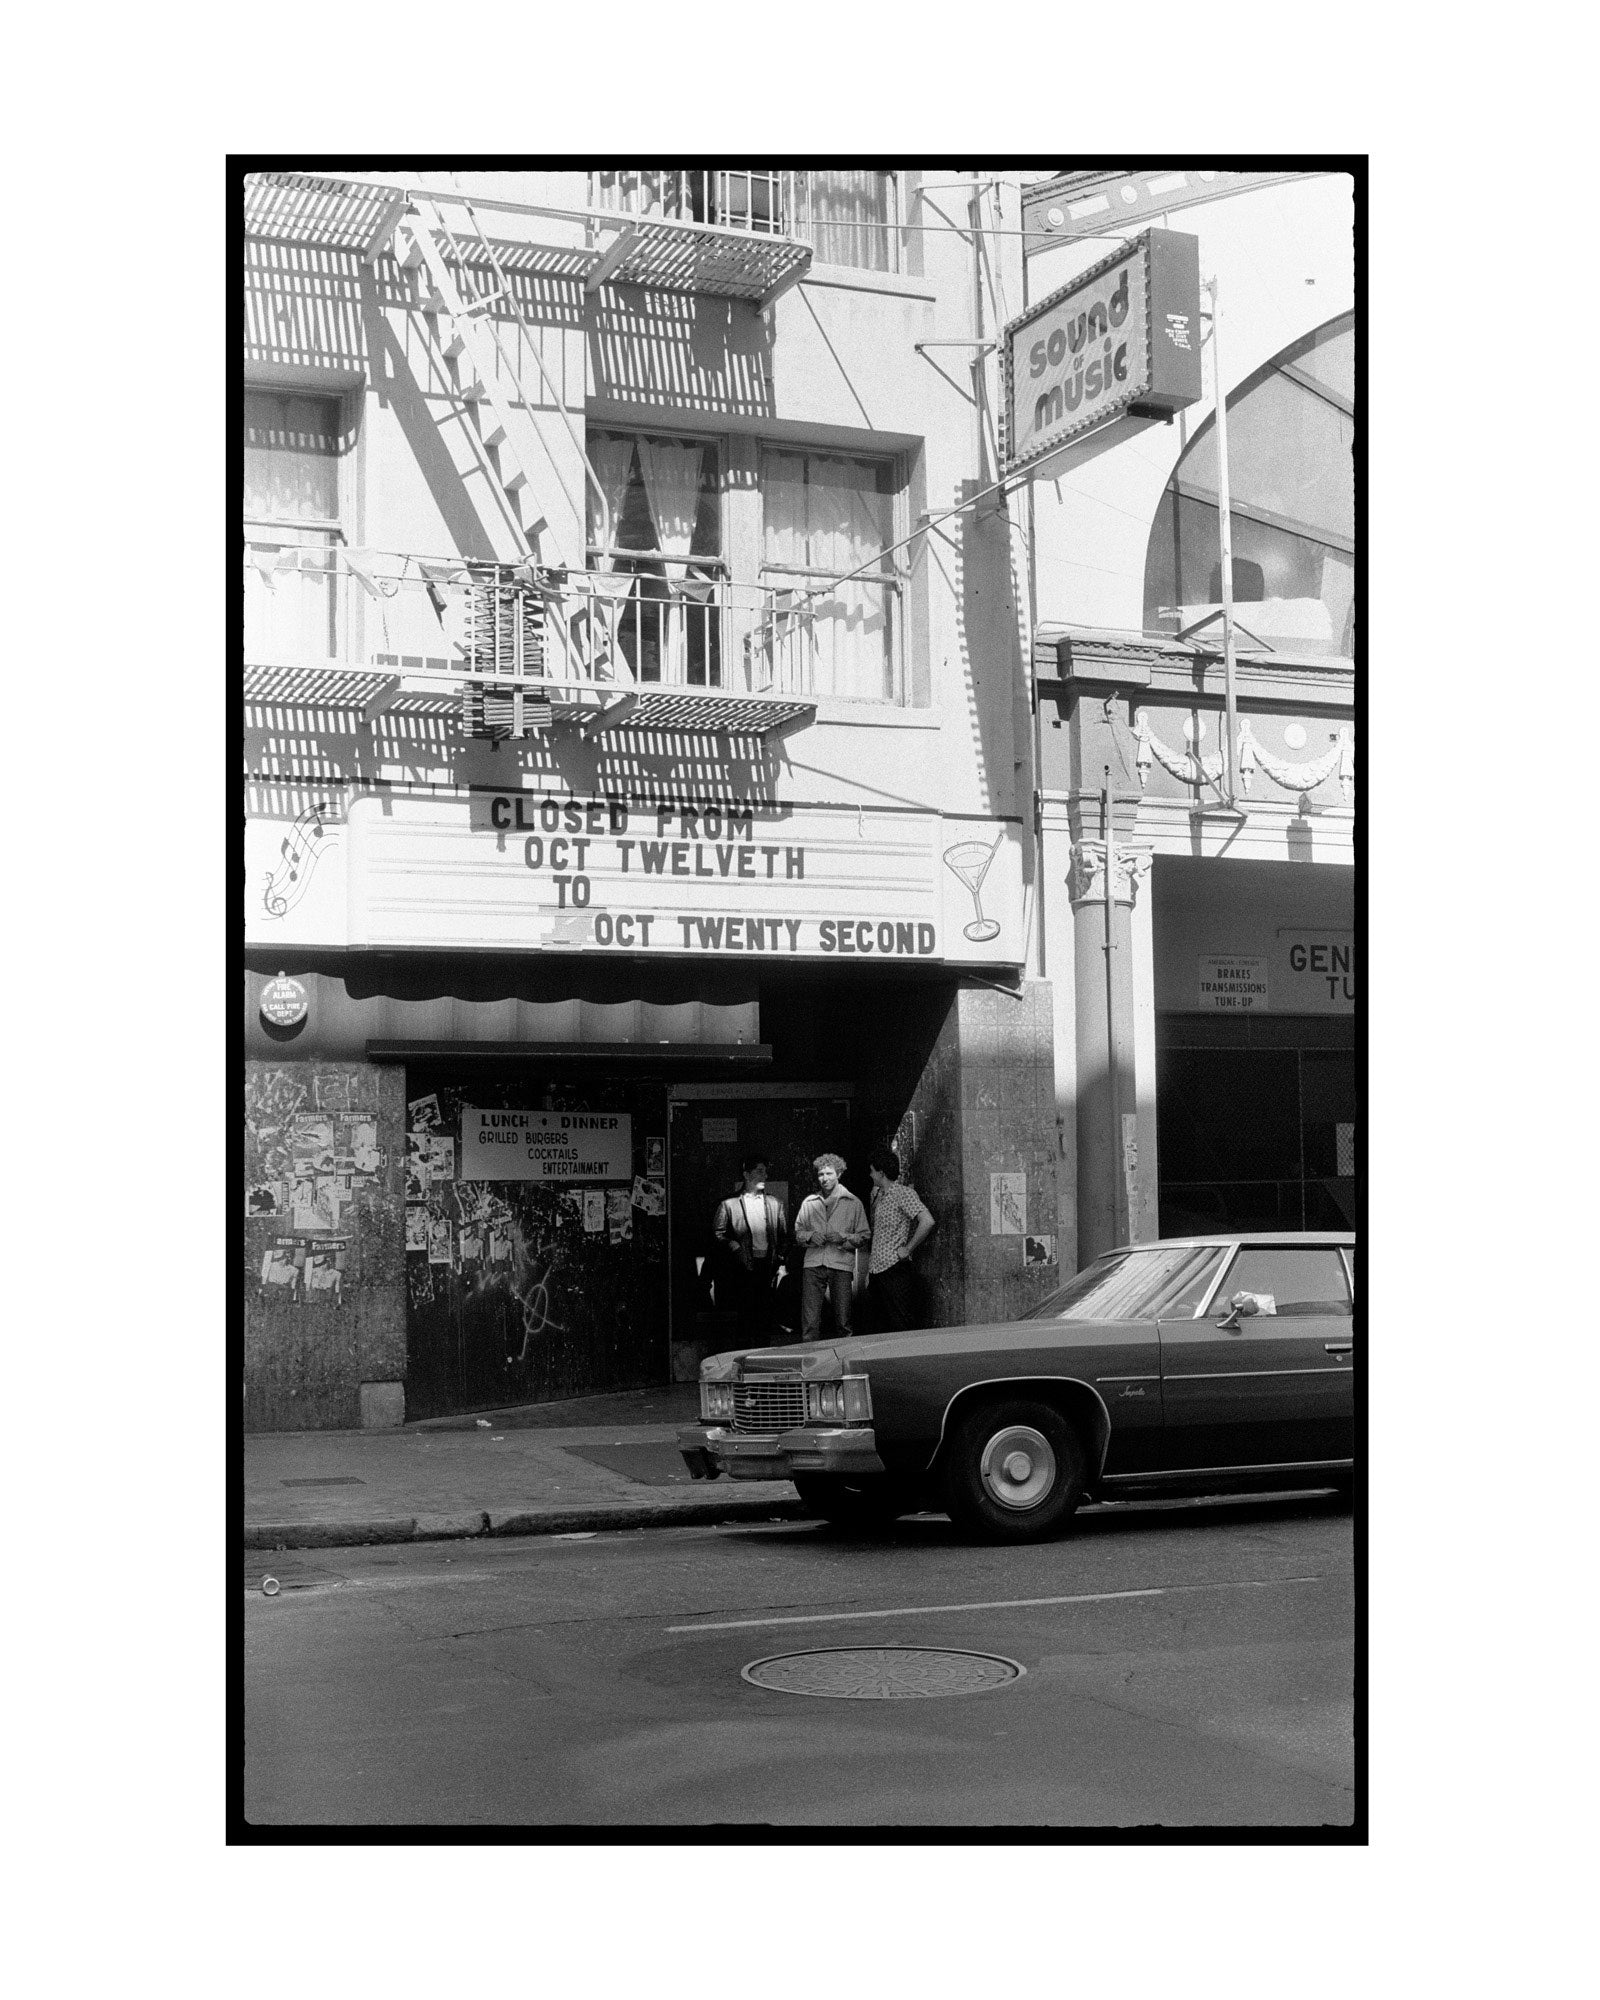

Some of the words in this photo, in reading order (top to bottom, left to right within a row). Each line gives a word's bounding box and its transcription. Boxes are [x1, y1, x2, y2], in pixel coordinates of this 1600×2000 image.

[1030, 269, 1129, 378] sound
[1073, 354, 1084, 371] OF
[1035, 337, 1127, 431] music
[491, 797, 629, 836] CLOSED
[656, 804, 753, 842] FROM
[524, 836, 591, 871] OCT
[616, 839, 805, 880] TWELVETH
[553, 875, 591, 909] TO
[594, 913, 655, 948] OCT
[677, 915, 802, 952] TWENTY
[819, 919, 936, 955] SECOND
[1289, 944, 1355, 973] GEN
[1217, 968, 1251, 980] BRAKES
[272, 991, 296, 999] ALARM
[1201, 982, 1267, 994] TRANSMISSIONS
[269, 1003, 286, 1011] CALL
[1215, 996, 1253, 1007] TUNE-UP
[295, 1114, 328, 1123] Farmers
[340, 1113, 372, 1122] Farmers
[481, 1114, 529, 1128] LUNCH
[560, 1116, 619, 1130] DINNER
[479, 1131, 519, 1145] GRILLED
[525, 1132, 569, 1146] BURGERS
[528, 1148, 579, 1160] COCKTAILS
[542, 1161, 610, 1175] ENTERTAINMENT
